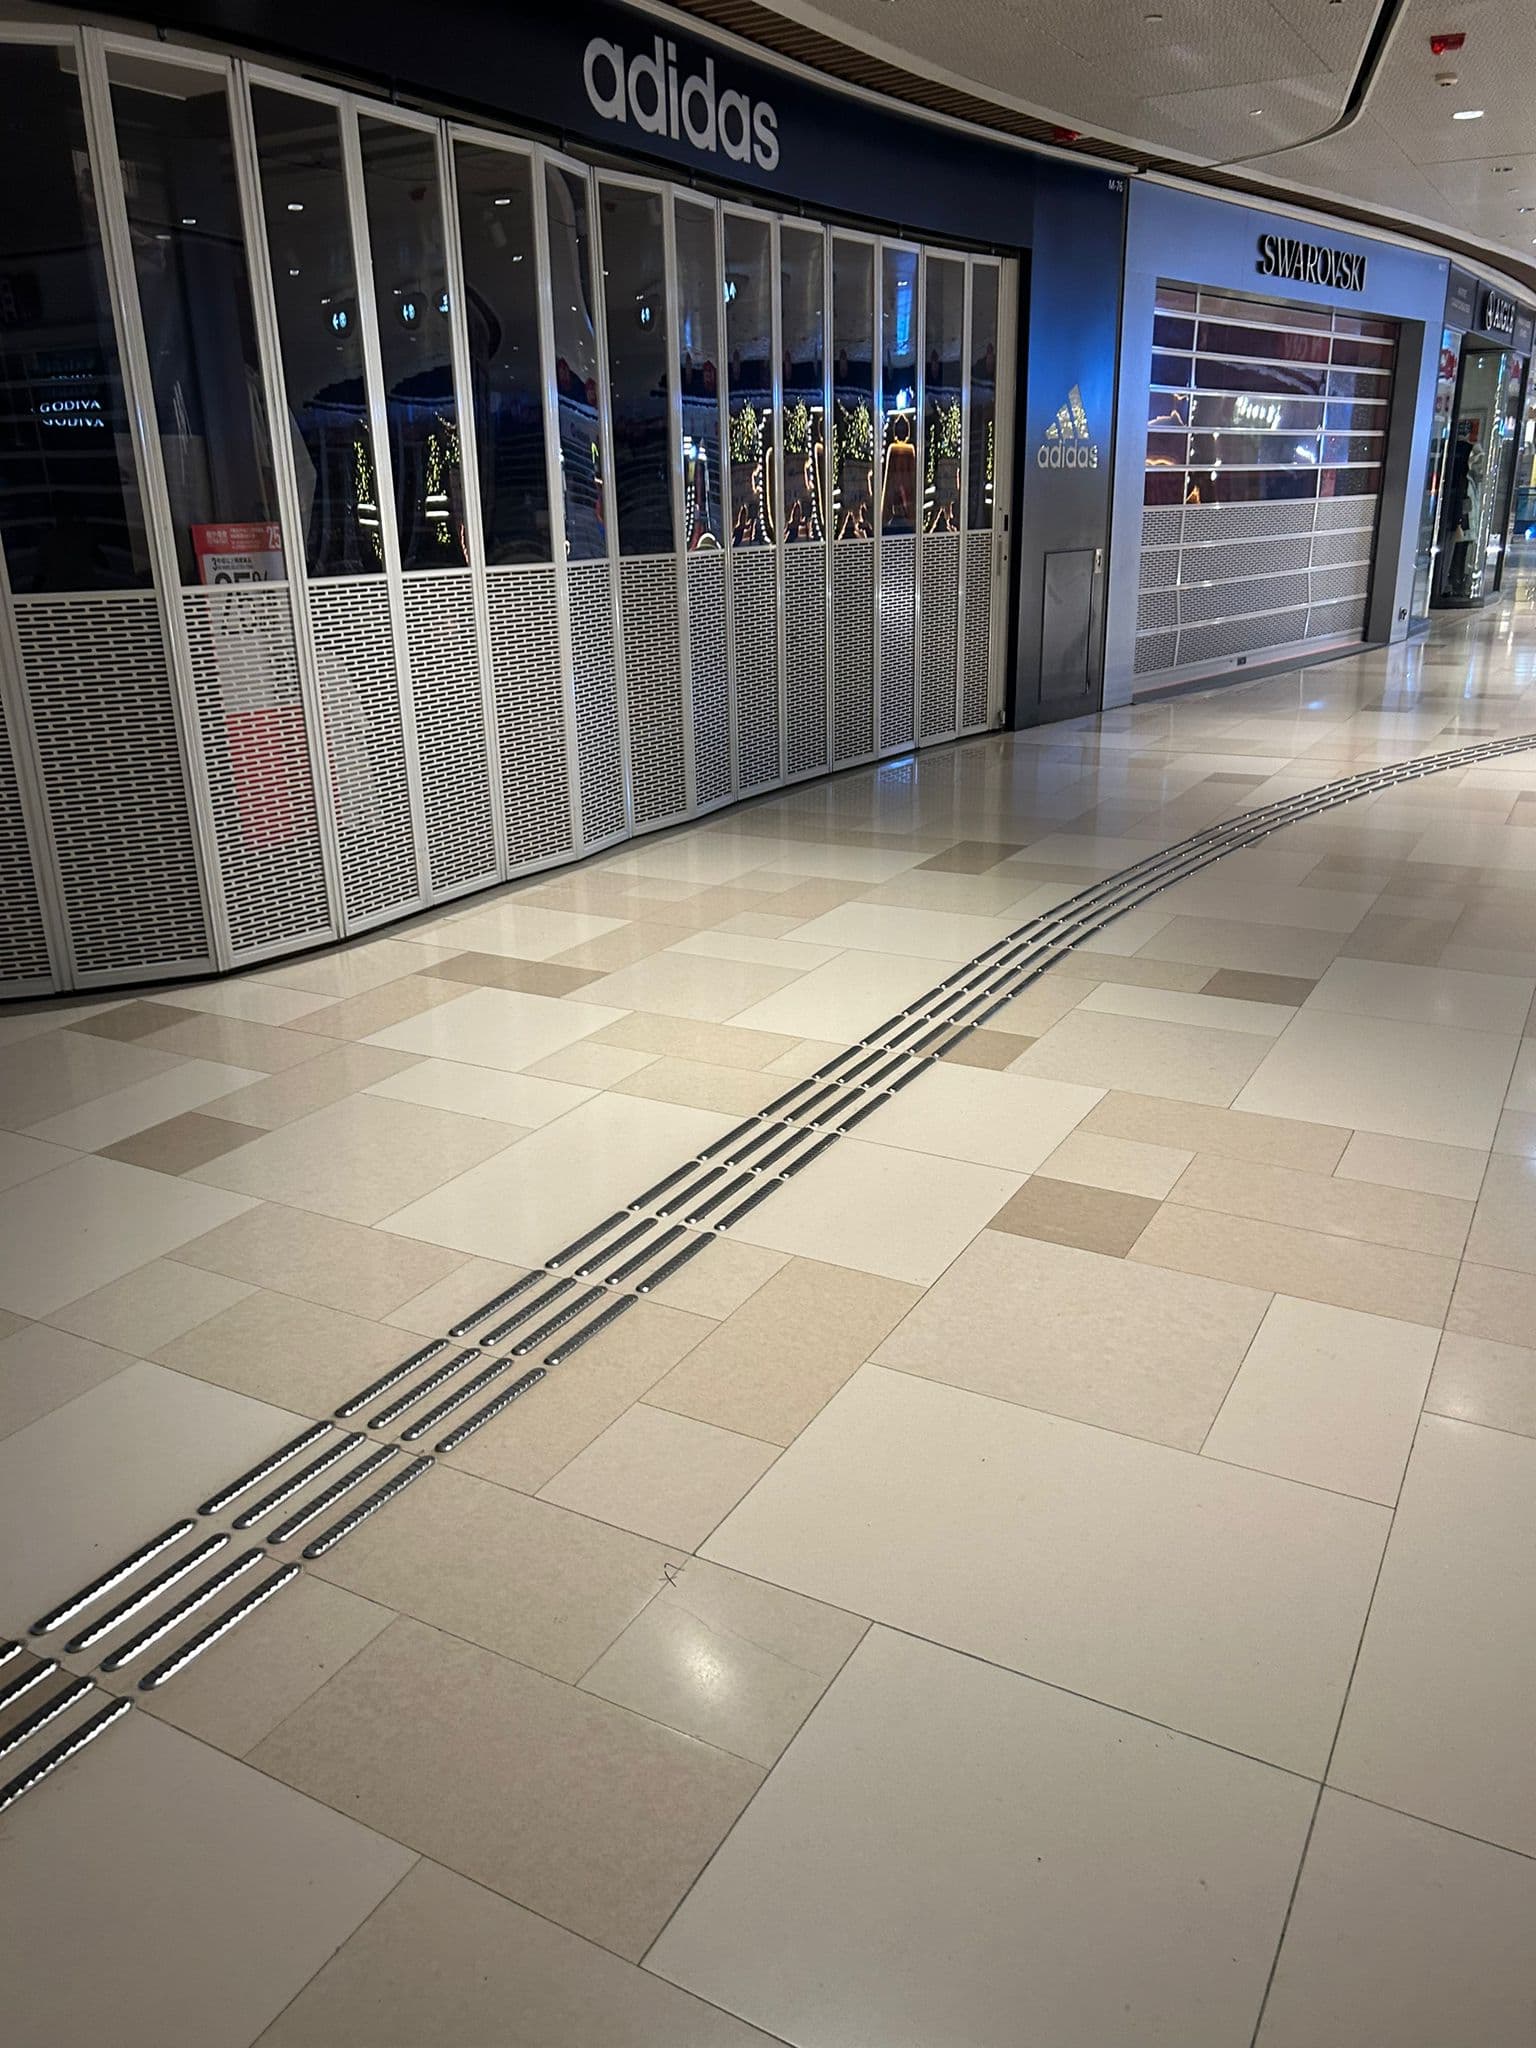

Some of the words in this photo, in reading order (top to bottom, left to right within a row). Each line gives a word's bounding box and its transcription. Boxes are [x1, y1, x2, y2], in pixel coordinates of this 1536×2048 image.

[583, 34, 780, 172] adidas
[1261, 234, 1368, 293] SWAROVSKI
[40, 400, 101, 413] GODIVA
[1037, 438, 1097, 468] adidas
